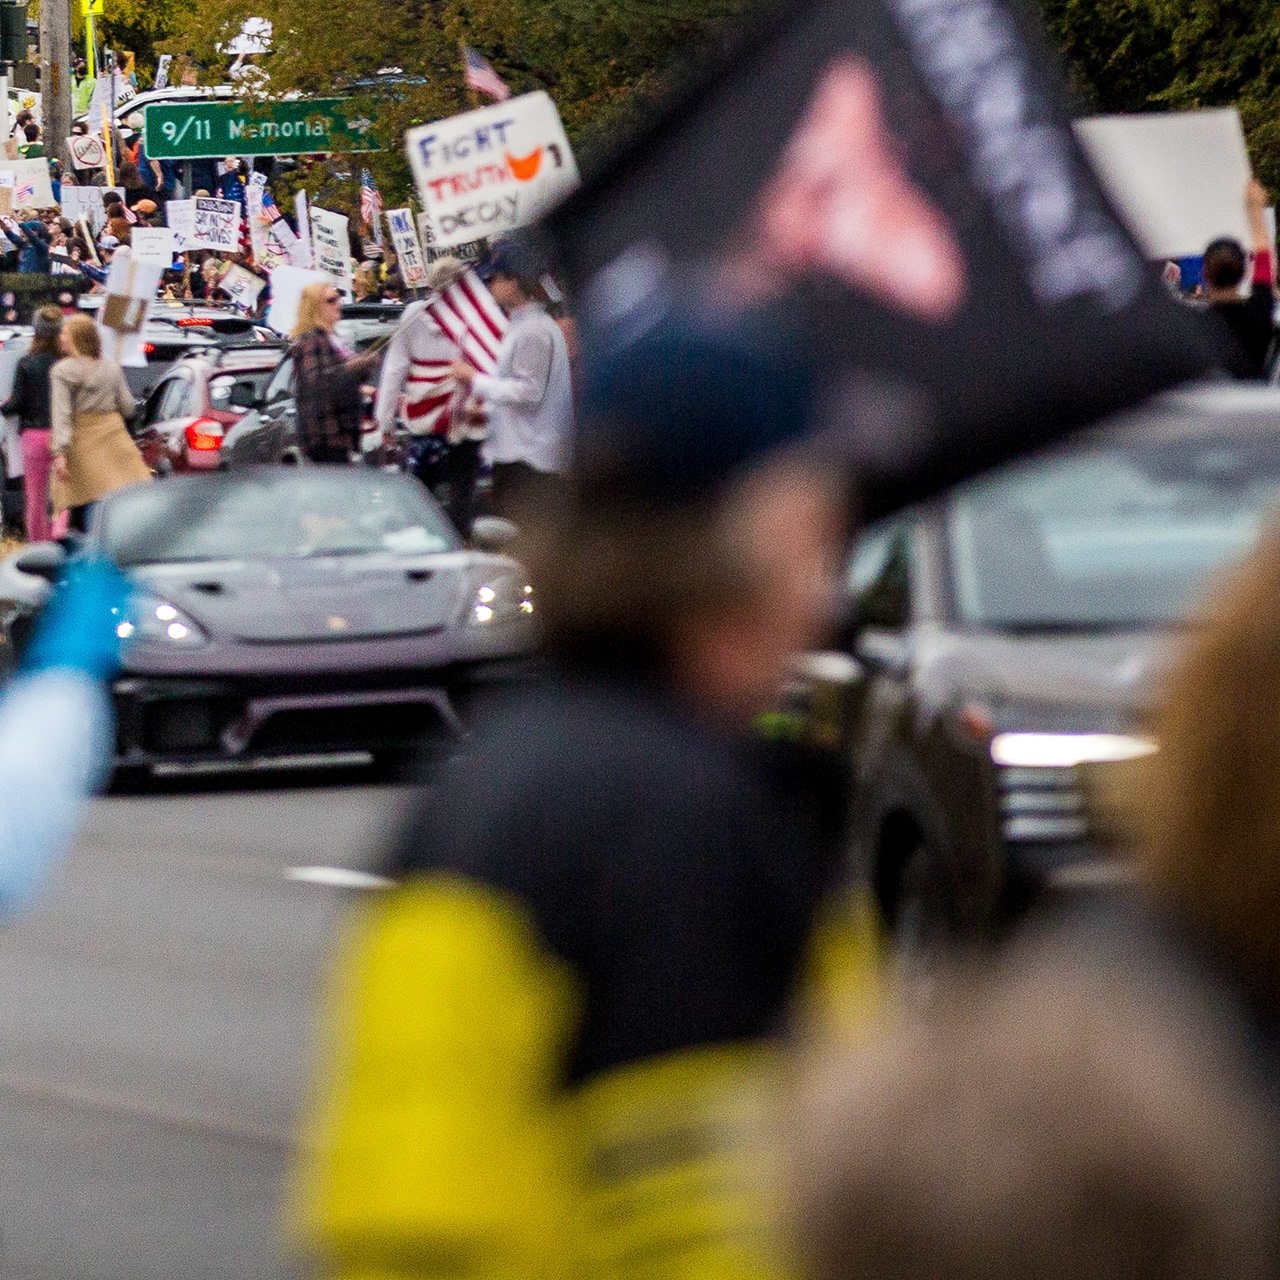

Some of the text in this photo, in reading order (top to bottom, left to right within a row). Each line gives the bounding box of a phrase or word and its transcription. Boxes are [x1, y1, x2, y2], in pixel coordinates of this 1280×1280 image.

[162, 116, 211, 146] 9/11
[419, 120, 514, 167] FIGHT
[441, 191, 521, 235] DECAY
